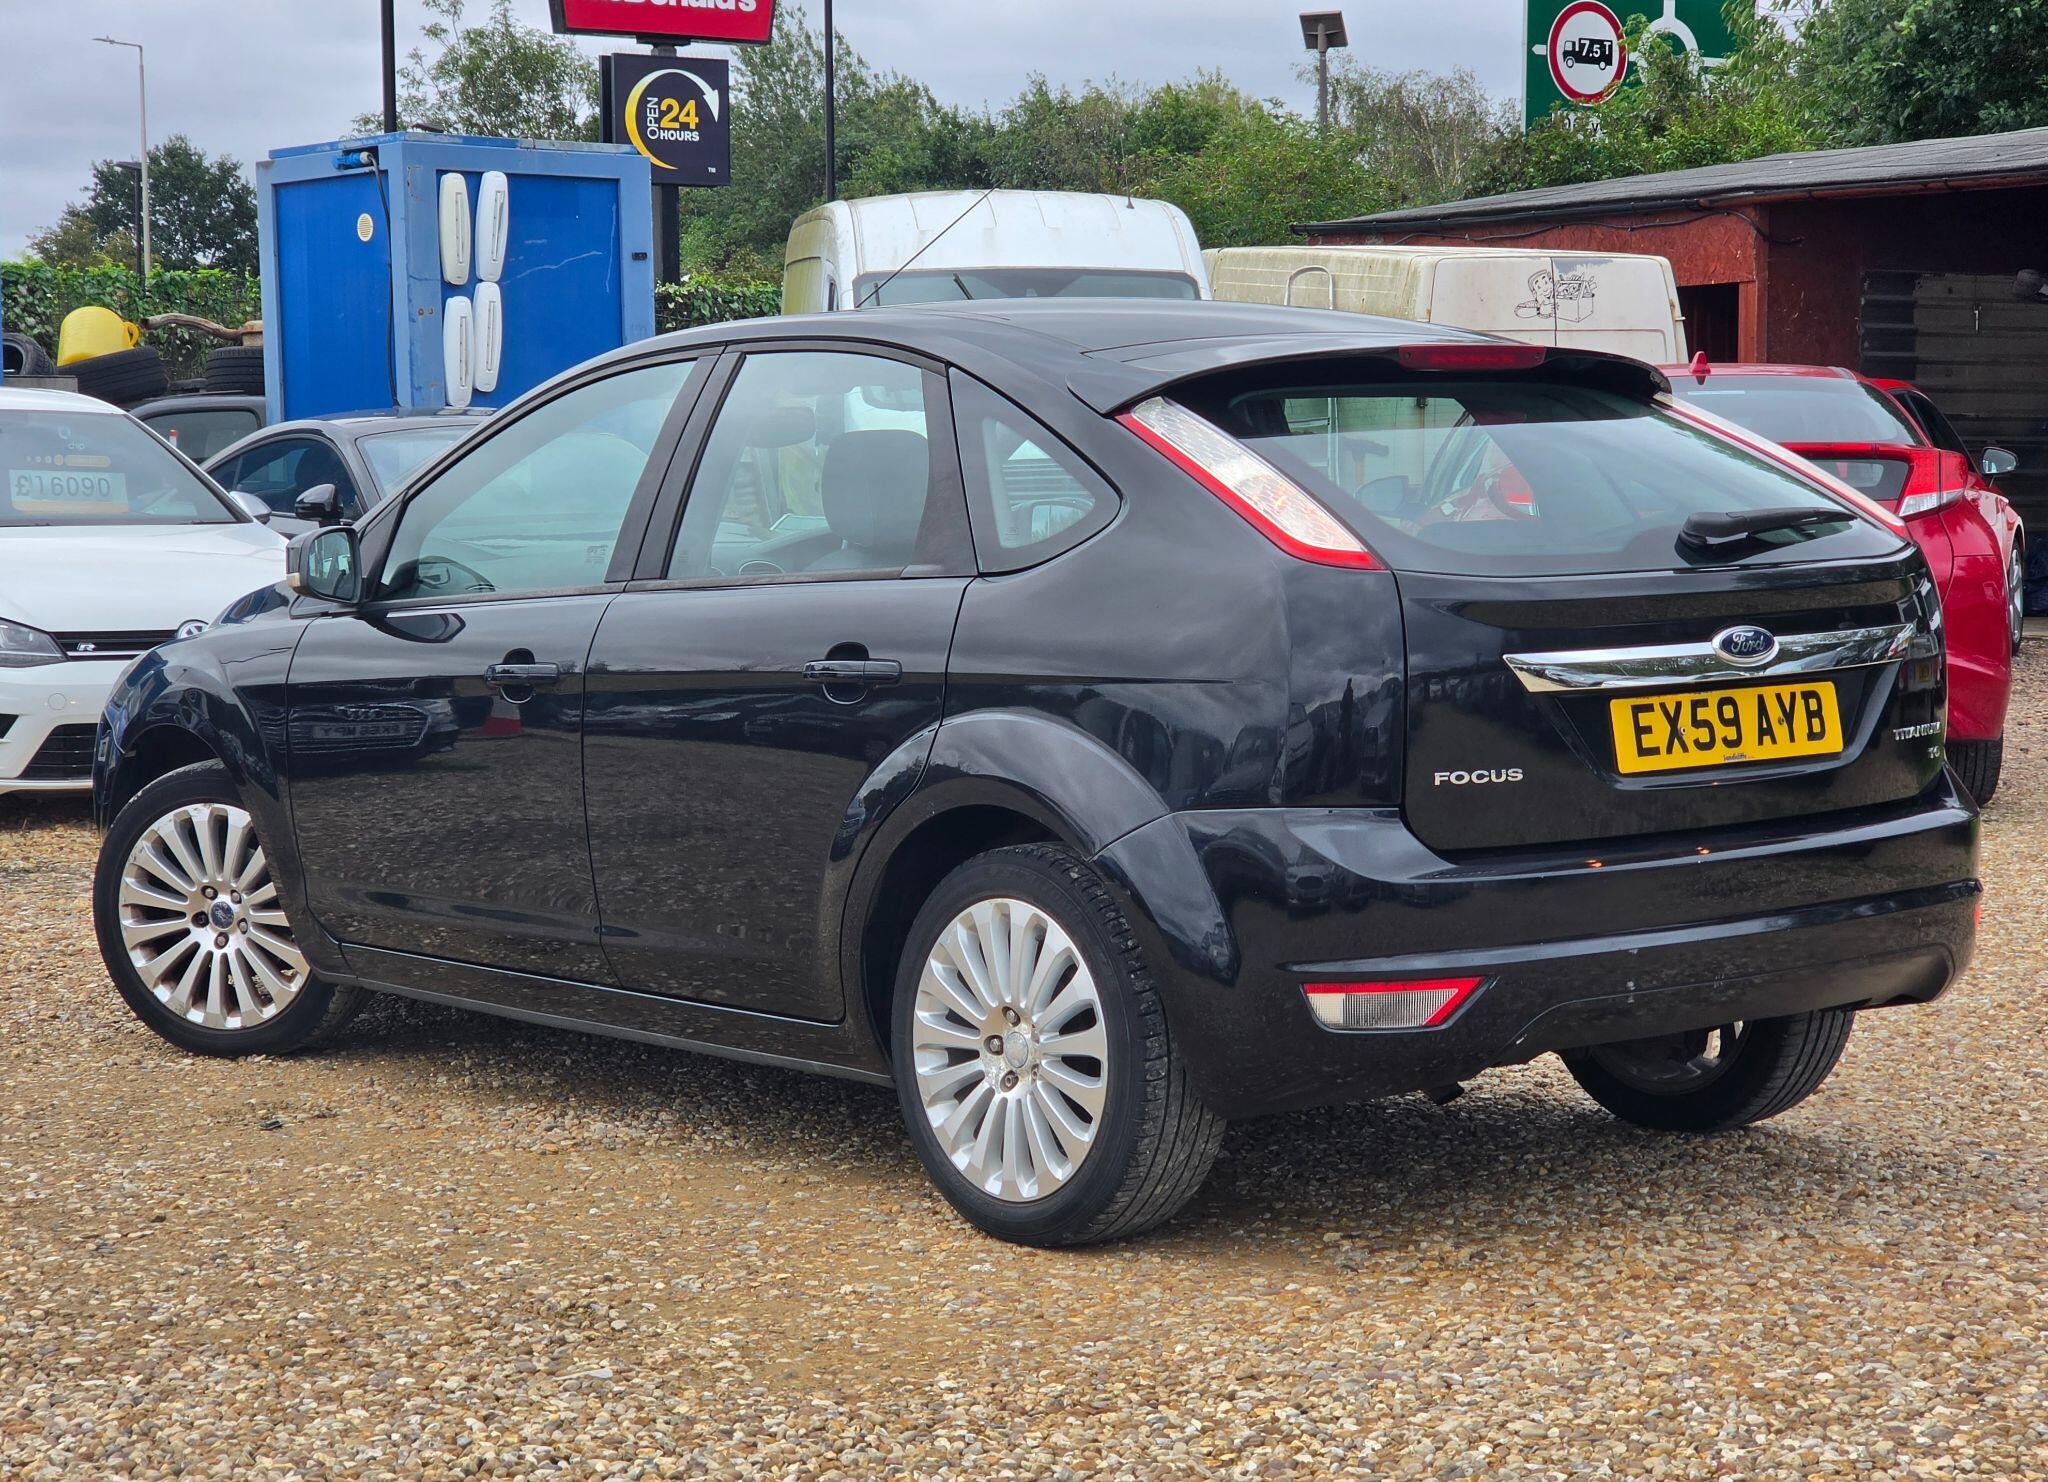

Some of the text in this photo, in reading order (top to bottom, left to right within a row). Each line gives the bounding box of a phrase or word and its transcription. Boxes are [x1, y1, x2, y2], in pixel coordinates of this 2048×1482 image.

[646, 97, 660, 140] OPEN
[659, 97, 699, 130] 24
[659, 129, 700, 142] HOURS
[76, 642, 96, 652] R
[1731, 631, 1765, 653] Ford
[1630, 689, 1827, 758] EX59 AYB
[1434, 767, 1524, 786] FOCUS
